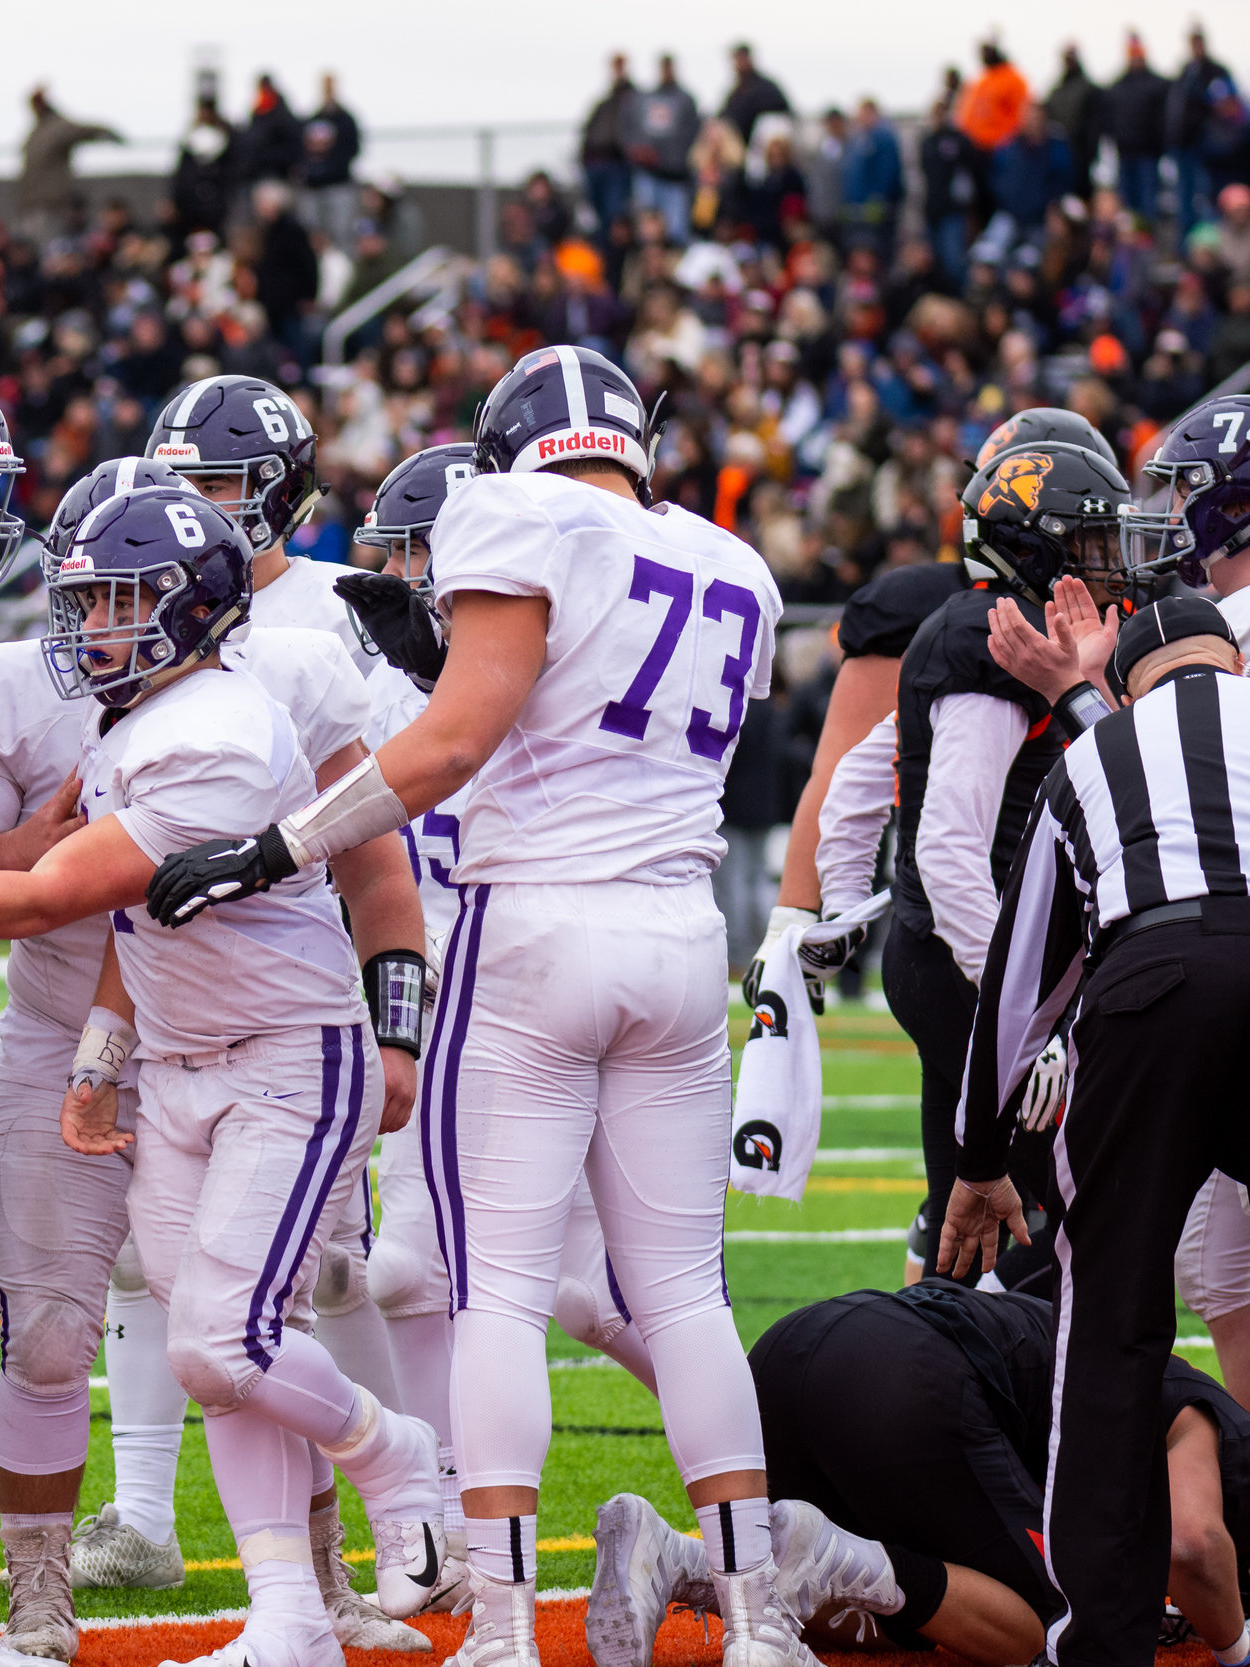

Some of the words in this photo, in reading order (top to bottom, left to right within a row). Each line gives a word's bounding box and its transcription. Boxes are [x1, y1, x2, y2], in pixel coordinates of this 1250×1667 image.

[253, 396, 306, 443] 67
[1213, 411, 1250, 454] 7
[538, 431, 626, 459] Riddell
[164, 503, 206, 548] 6
[61, 558, 87, 571] Riddell
[598, 553, 760, 762] 73
